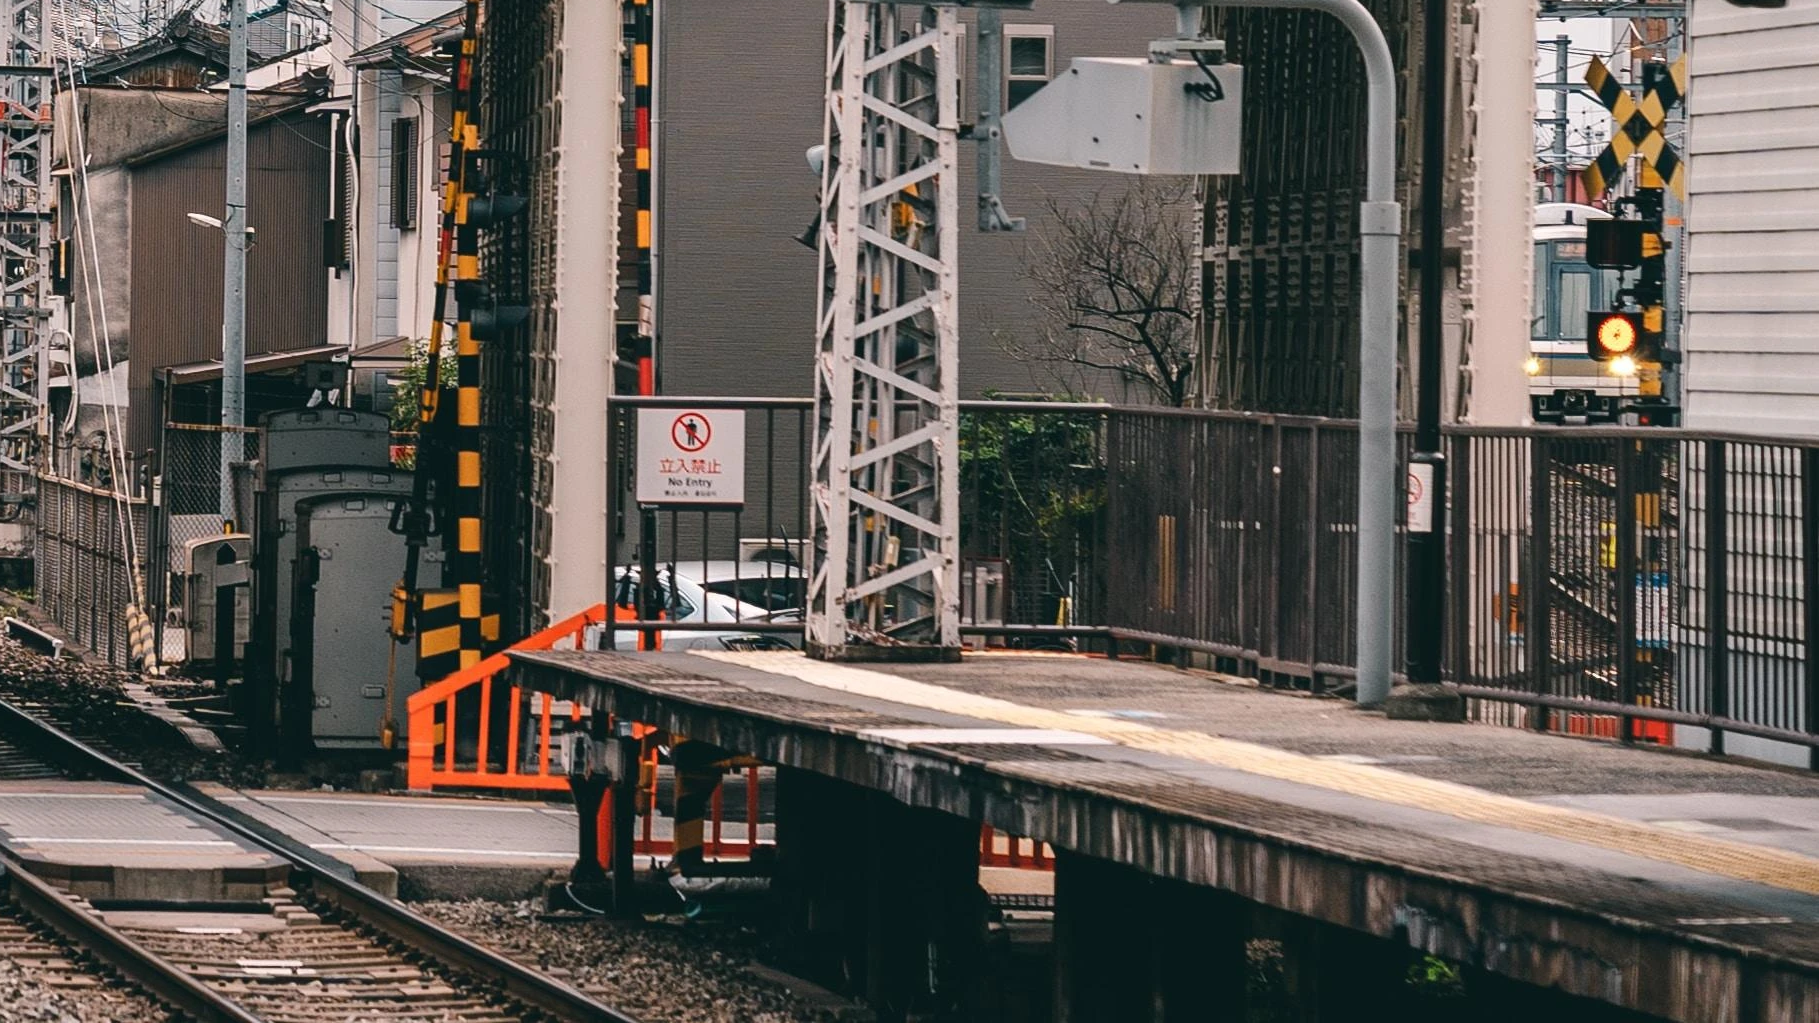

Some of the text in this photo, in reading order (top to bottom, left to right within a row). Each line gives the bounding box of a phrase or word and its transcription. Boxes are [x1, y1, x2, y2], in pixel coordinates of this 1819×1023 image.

[659, 458, 722, 474] 立入禁止
[668, 477, 713, 489] No Entry
